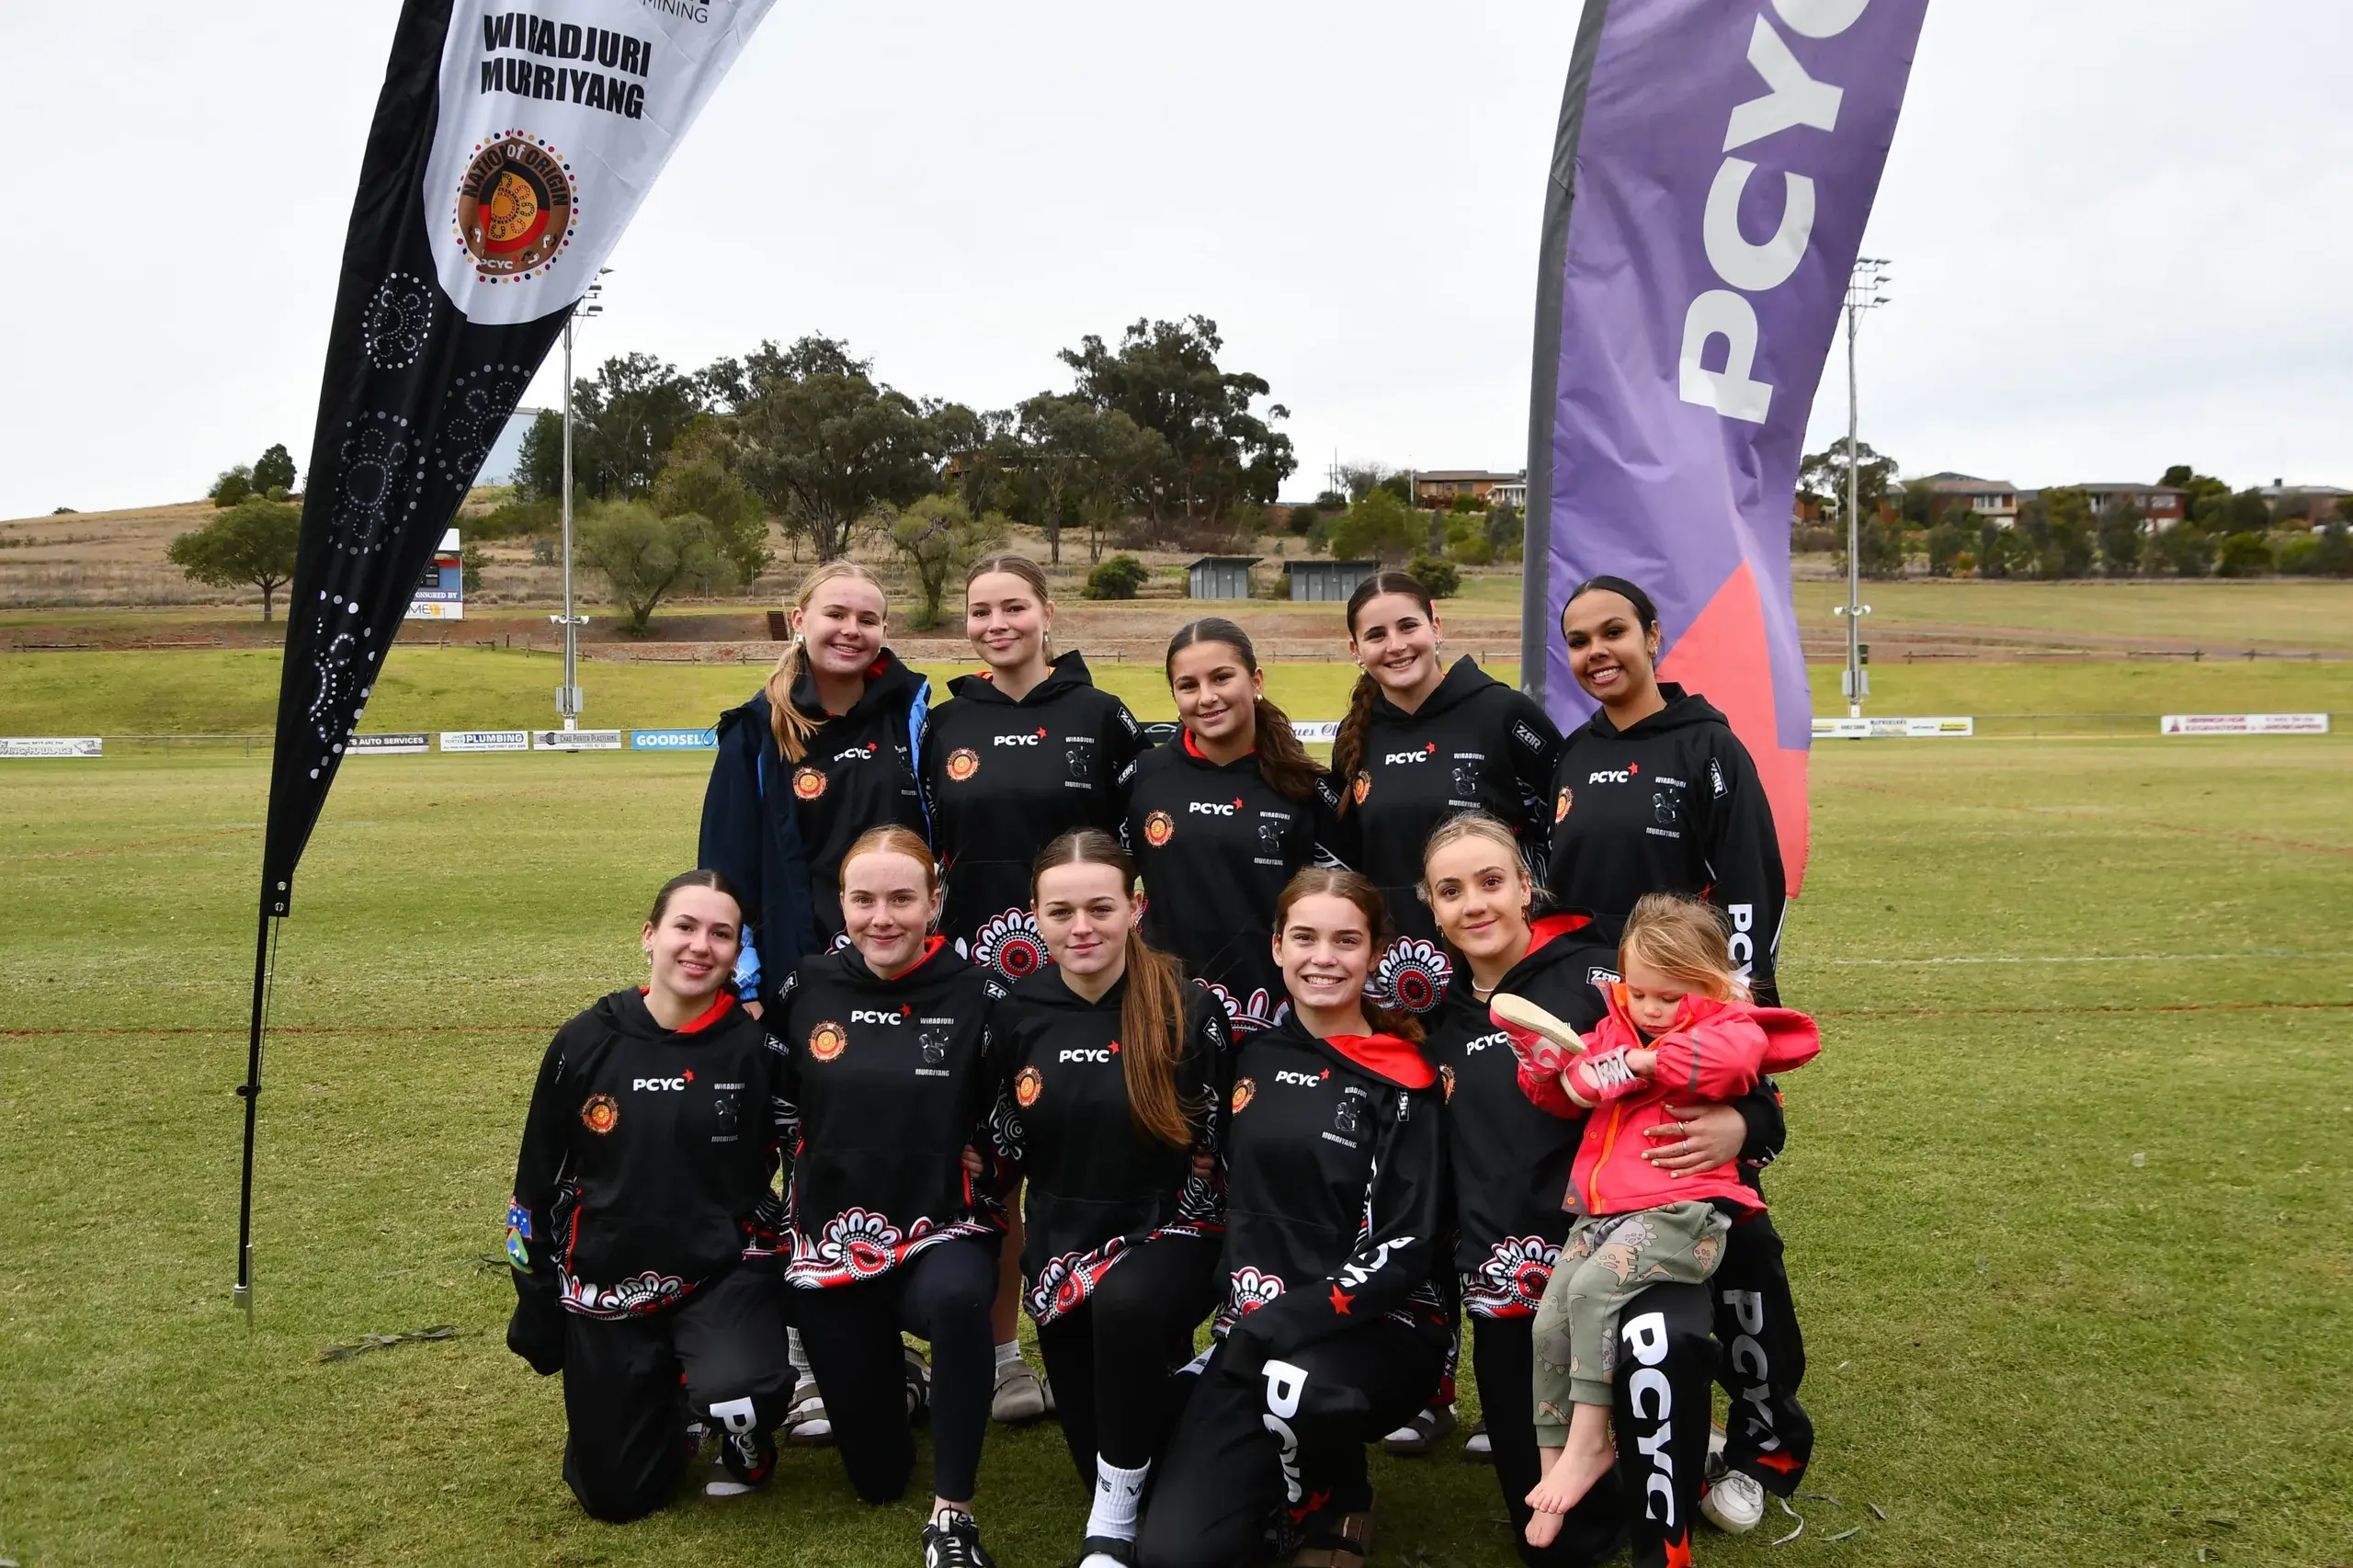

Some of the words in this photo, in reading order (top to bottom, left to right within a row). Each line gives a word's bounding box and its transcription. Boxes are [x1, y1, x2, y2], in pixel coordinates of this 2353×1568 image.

[483, 13, 652, 78] WIRADJURI
[481, 57, 645, 119] MURRIYANG
[461, 143, 508, 198] NATION
[506, 144, 527, 160] of
[525, 149, 569, 206] ORIGIN
[1679, 0, 1870, 425] PCY
[479, 258, 514, 269] PCYC
[466, 733, 523, 743] PLUMBING
[994, 734, 1039, 746] PCYC
[833, 747, 872, 762] PCYC
[1385, 750, 1427, 766] PCYC
[1588, 770, 1629, 785] PCYC
[1188, 801, 1234, 816] PCYC
[1259, 811, 1290, 821] WIRADJURI
[851, 1010, 902, 1026] PCYC
[1466, 1031, 1508, 1055] PCYC
[1059, 1049, 1110, 1062] PCYC
[915, 1068, 950, 1077] MURRIYANG
[1275, 1070, 1321, 1087] PCYC
[633, 1078, 685, 1091] PCYC
[1322, 1131, 1358, 1149] MURRIYANG
[1621, 1312, 1676, 1528] PCYC
